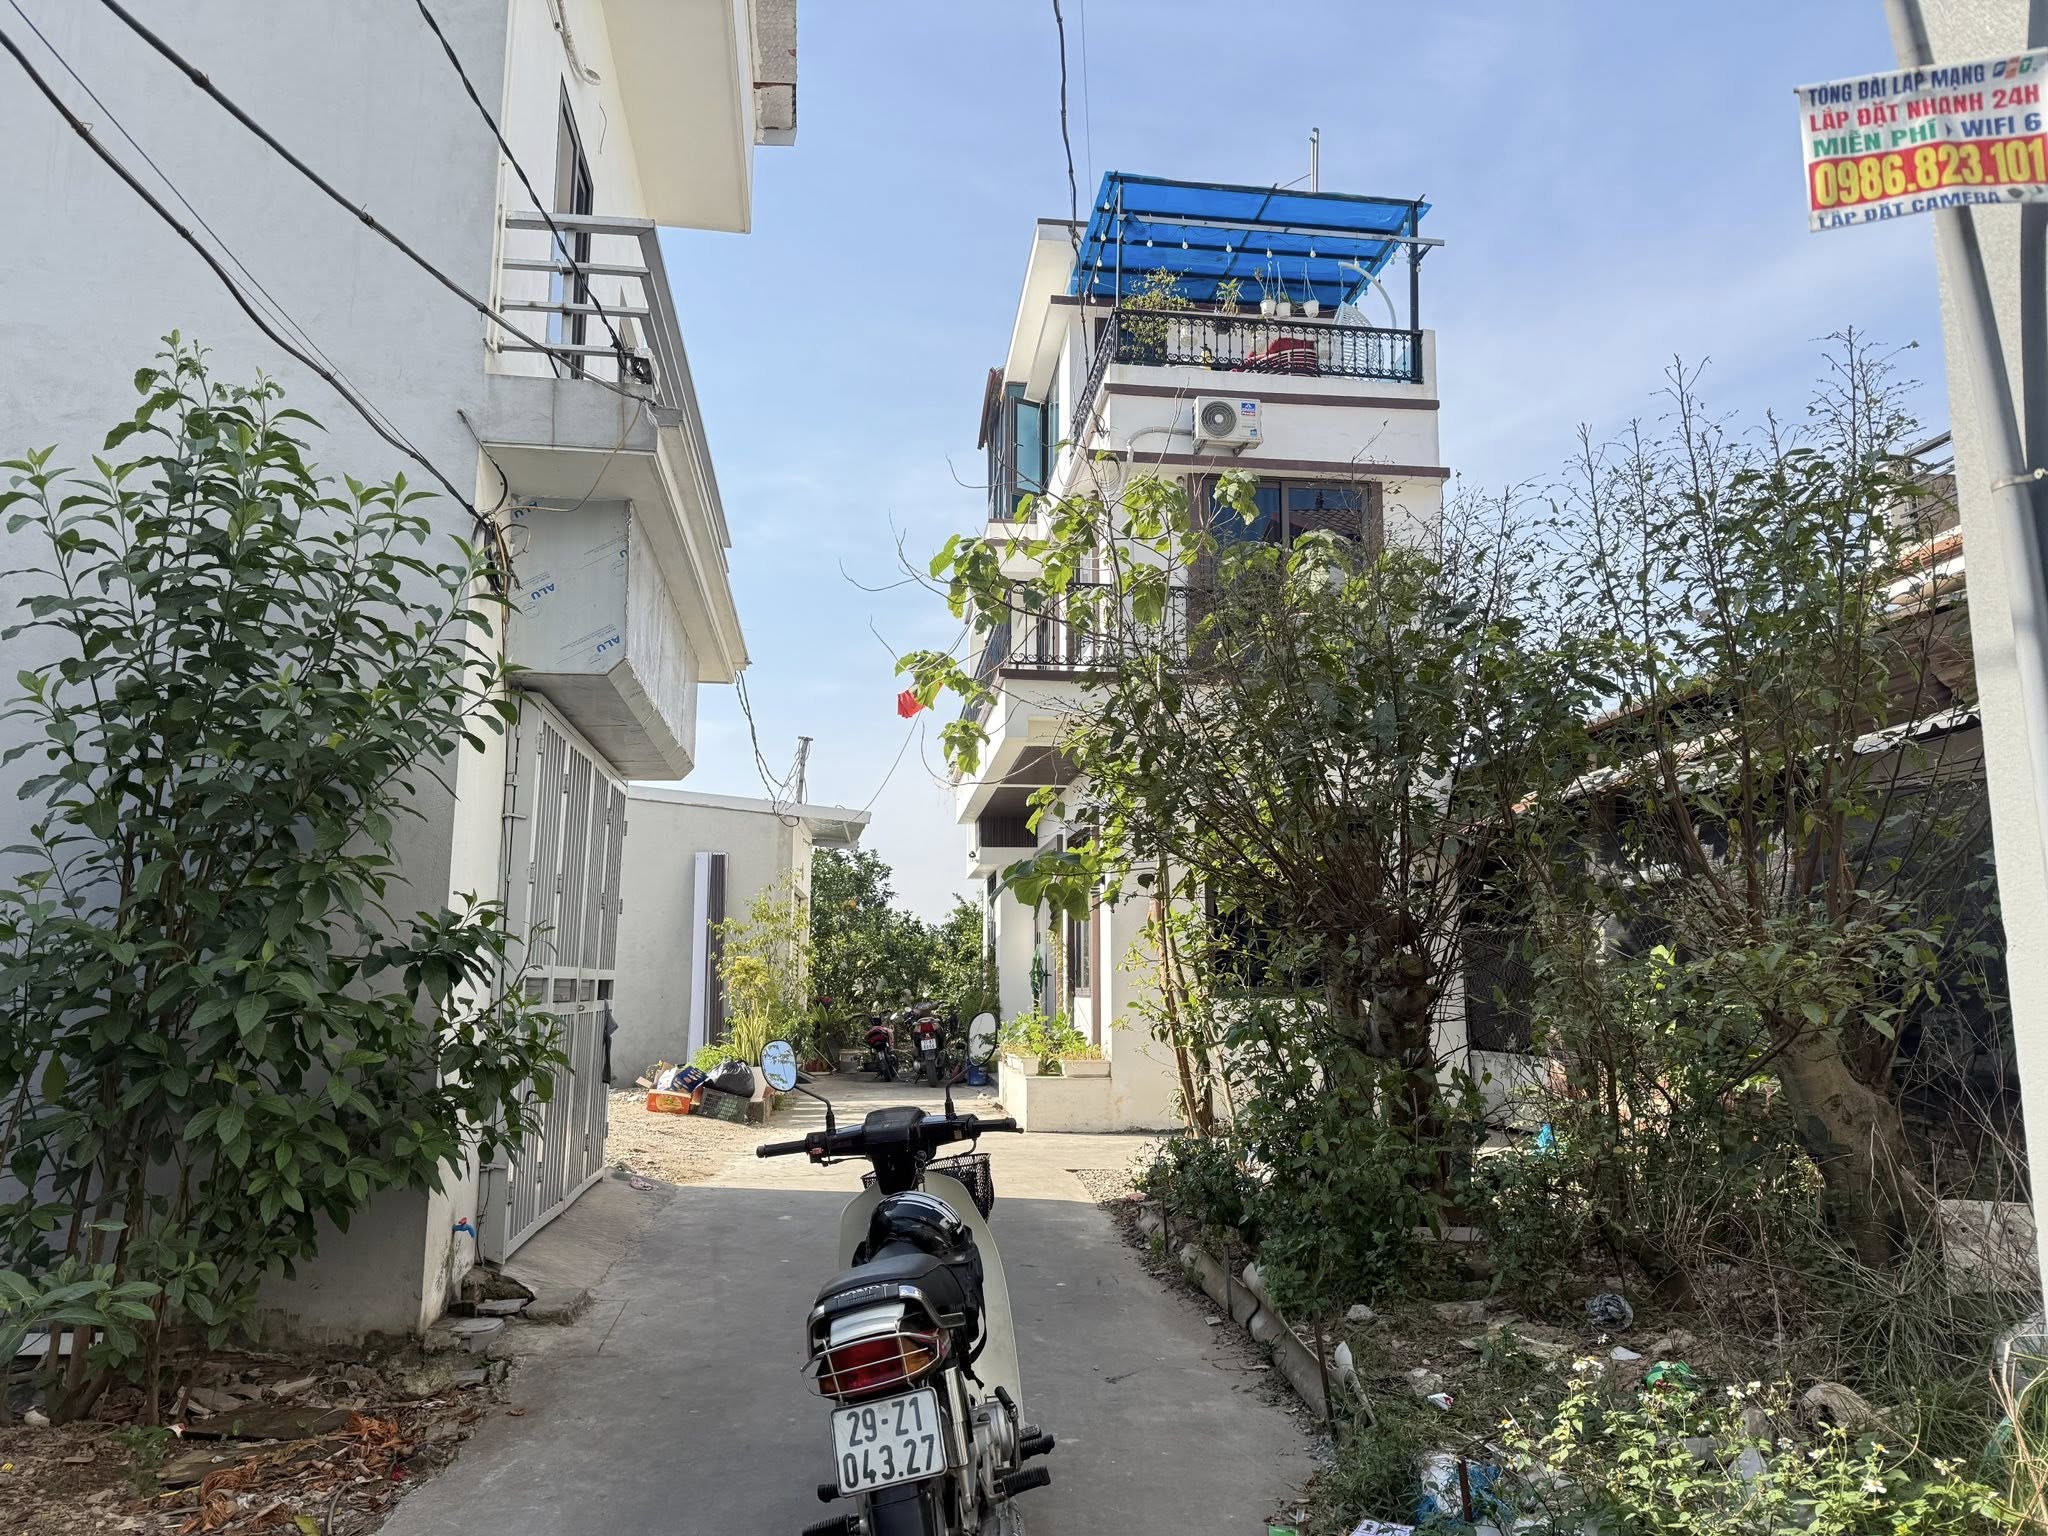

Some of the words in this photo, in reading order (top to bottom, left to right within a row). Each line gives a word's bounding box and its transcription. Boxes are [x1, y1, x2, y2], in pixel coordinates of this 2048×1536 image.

[1931, 64, 1985, 91] MẠNG
[1809, 106, 1849, 132] LẮP
[1857, 101, 1898, 128] ĐẶT
[1907, 91, 1983, 121] NHANH
[1992, 84, 2040, 110] 24H
[1891, 118, 1937, 148] PHÍ
[1960, 116, 2015, 138] WIFI
[2024, 112, 2042, 132] 6
[1815, 137, 2047, 207] 0986.823.101
[1911, 190, 2001, 213] CAMERA
[530, 583, 556, 601] ALU
[595, 635, 621, 653] ALU
[846, 1396, 922, 1447] 29-Z1
[842, 1433, 935, 1489] 043.27
